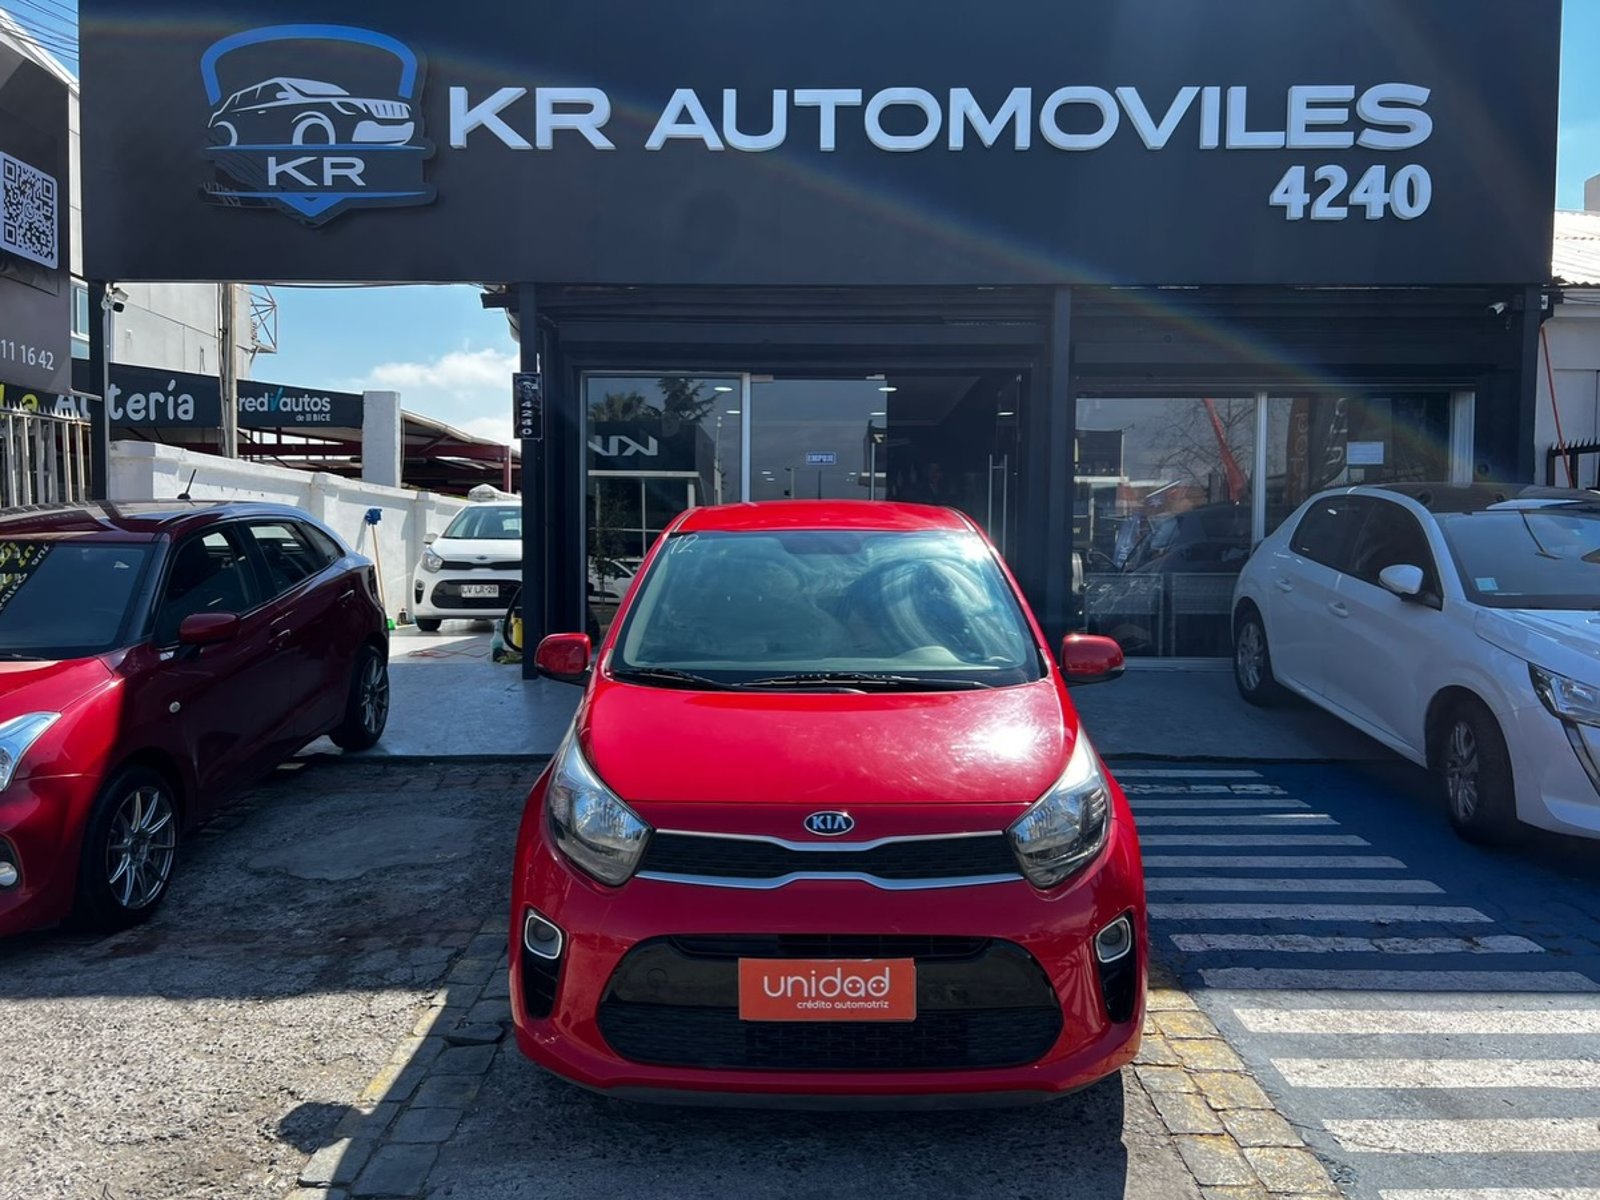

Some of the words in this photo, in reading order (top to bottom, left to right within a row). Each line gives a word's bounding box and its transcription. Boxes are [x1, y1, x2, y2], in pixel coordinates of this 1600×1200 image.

[448, 86, 616, 151] KR
[645, 83, 1433, 153] AUTOMOVILES
[267, 156, 367, 187] KR
[1268, 163, 1433, 221] 4240
[20, 344, 36, 366] 16
[38, 349, 54, 371] 42
[811, 814, 848, 830] KIA
[763, 966, 890, 998] unidad
[796, 999, 833, 1010] crédito
[833, 1000, 890, 1010] automotriz
